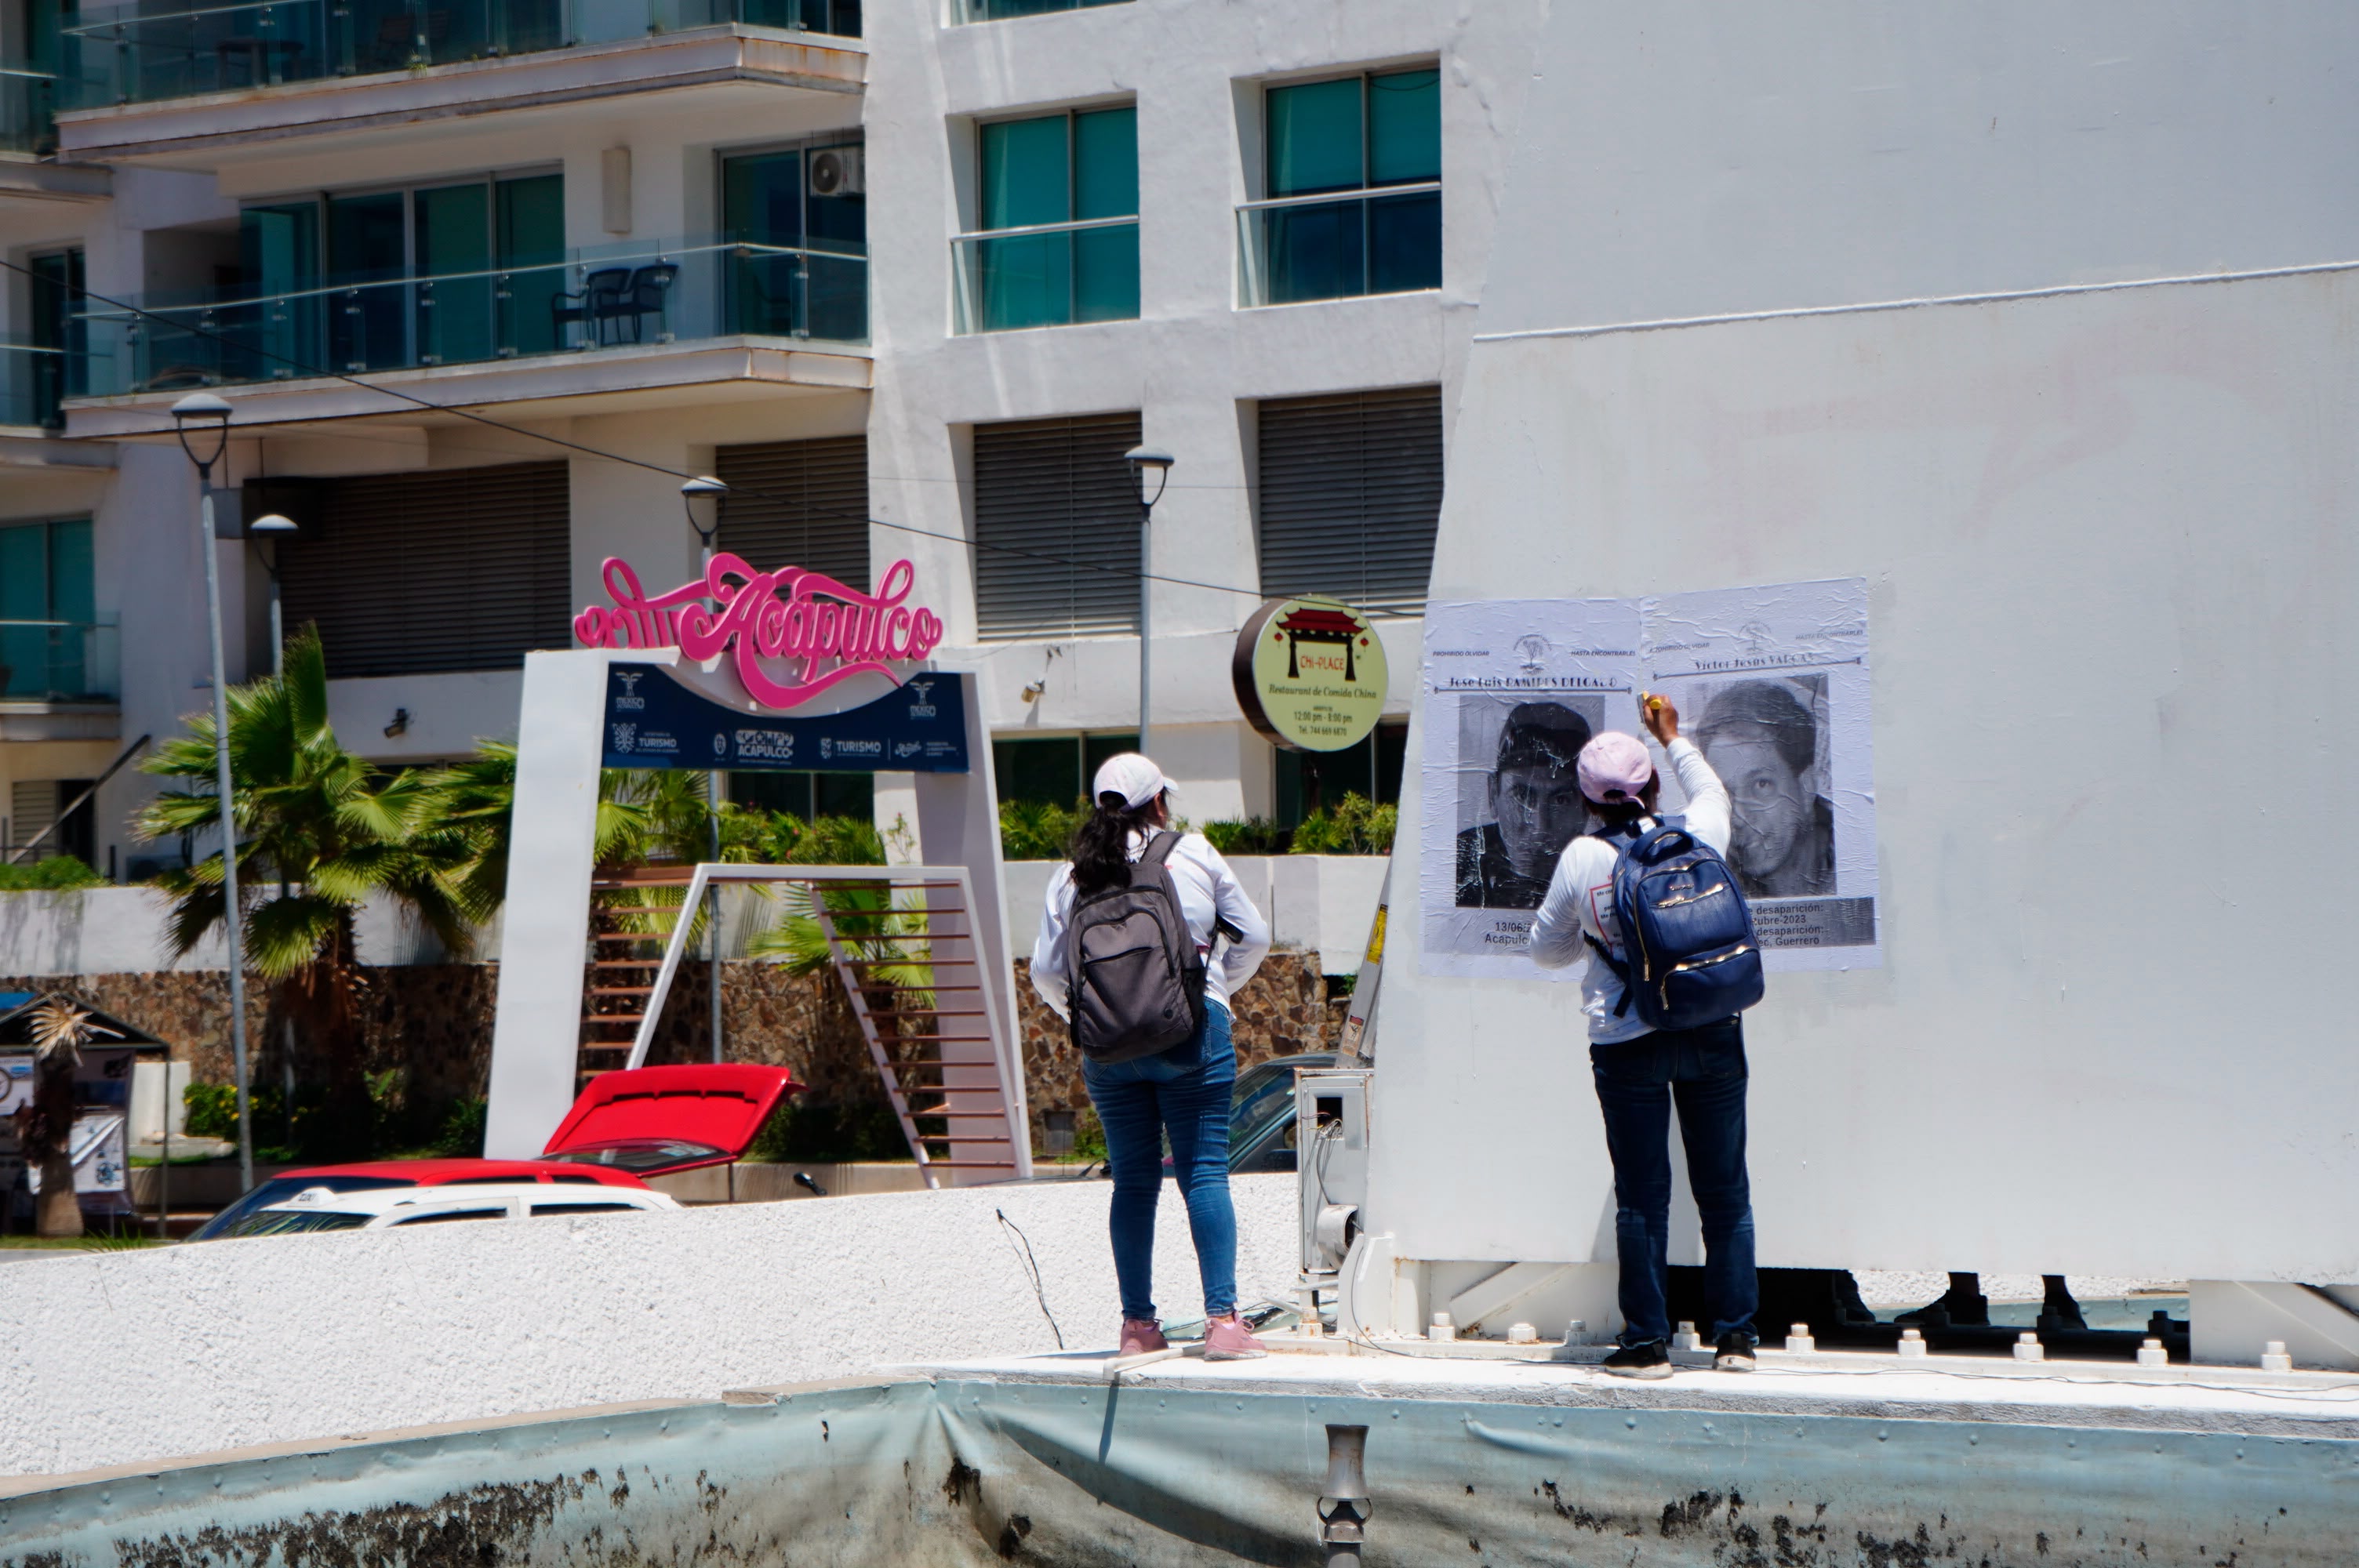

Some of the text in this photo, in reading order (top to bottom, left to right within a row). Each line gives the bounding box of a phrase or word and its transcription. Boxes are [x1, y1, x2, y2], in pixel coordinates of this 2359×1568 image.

[678, 552, 943, 710] Acapulco
[1299, 655, 1345, 670] CHI-PLACE
[1269, 684, 1377, 699] Restaurant de Comida China
[638, 738, 677, 747] TURISMO
[837, 741, 881, 753] TURISMO
[738, 746, 793, 758] ACAPULCO
[1757, 904, 1823, 916] desaparición:
[1757, 925, 1824, 938] desaparición:
[1485, 934, 1529, 946] Acapulc
[1776, 937, 1819, 946] Guerrero
